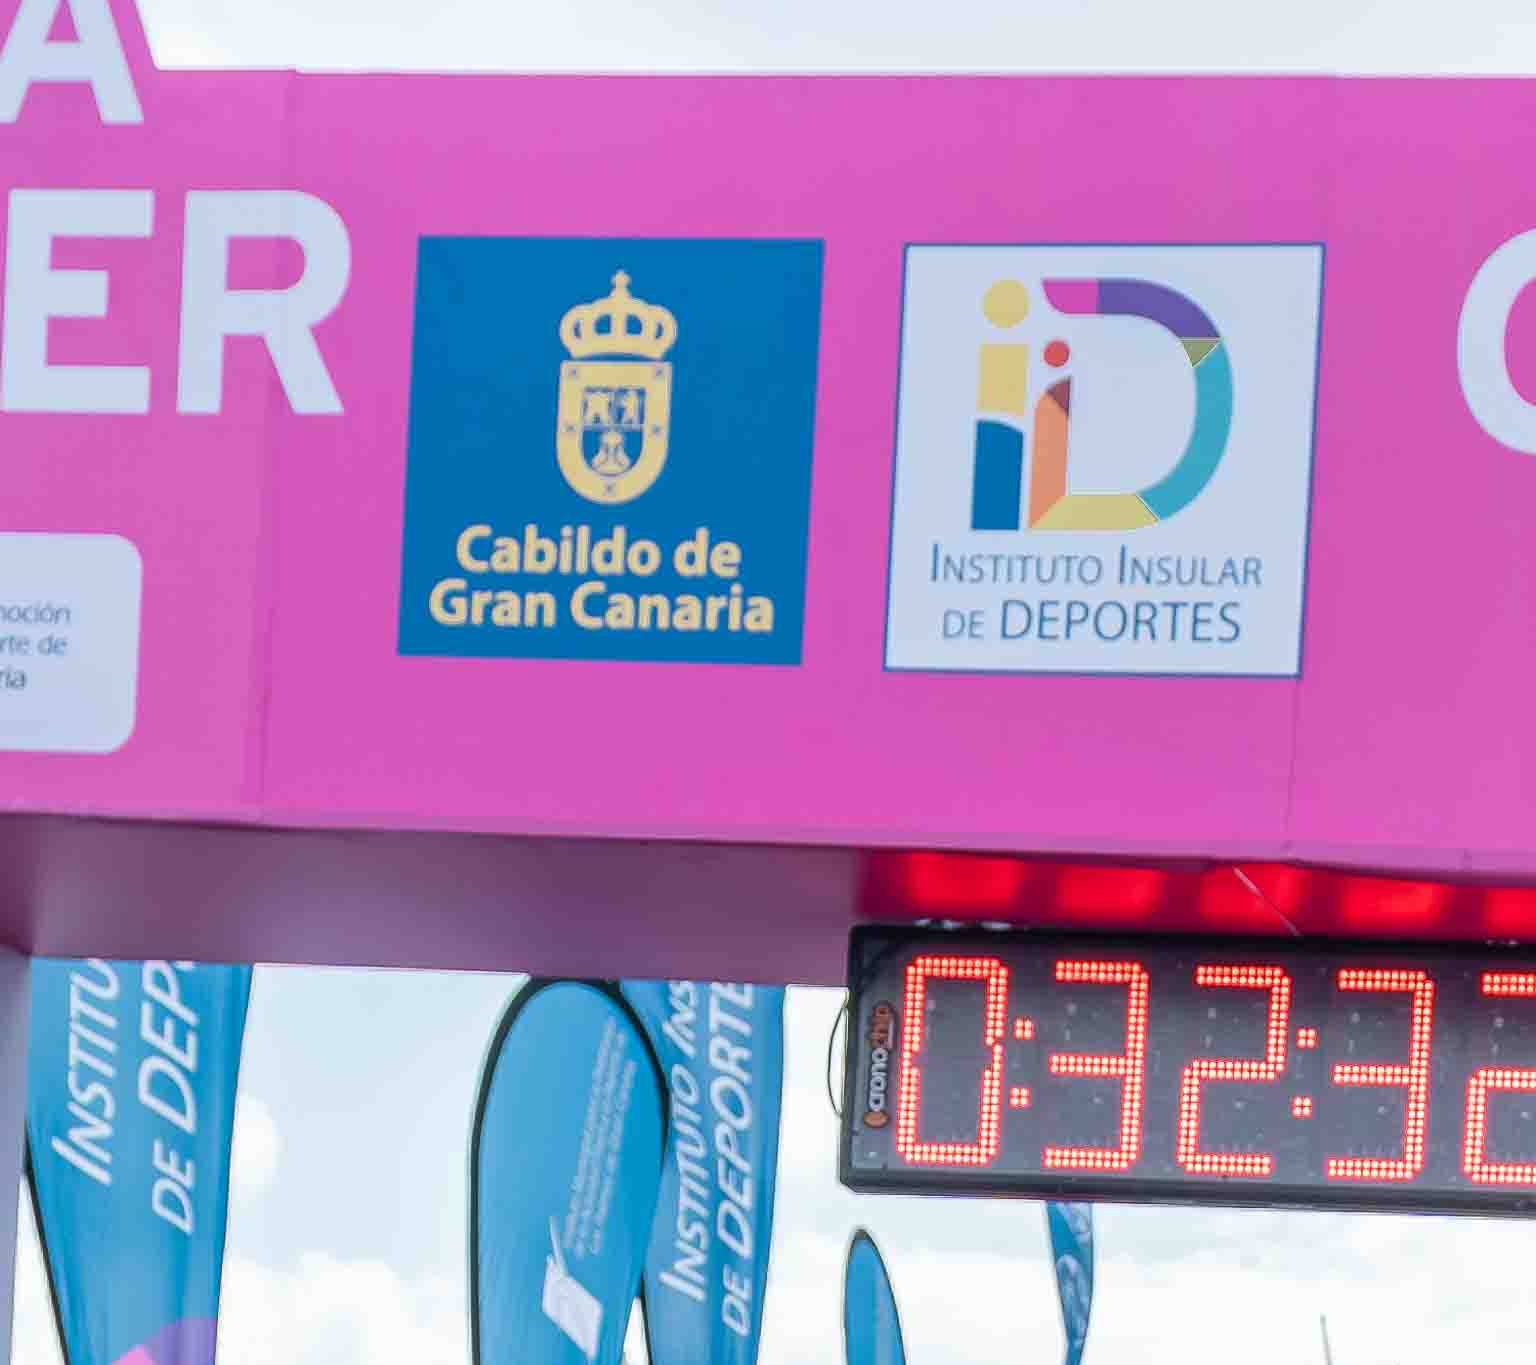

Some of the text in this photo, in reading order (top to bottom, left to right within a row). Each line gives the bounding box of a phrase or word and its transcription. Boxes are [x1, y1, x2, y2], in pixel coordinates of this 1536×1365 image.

[456, 524, 742, 578] Cabildo de
[930, 542, 1264, 589] INSTITUTO INSULAR
[429, 577, 774, 633] Gran Canaria
[942, 599, 1241, 643] DE DEPORTES
[37, 634, 68, 657] de
[151, 1137, 198, 1235] DE
[659, 1062, 709, 1302] INSTITUTO
[722, 1266, 752, 1337] DE
